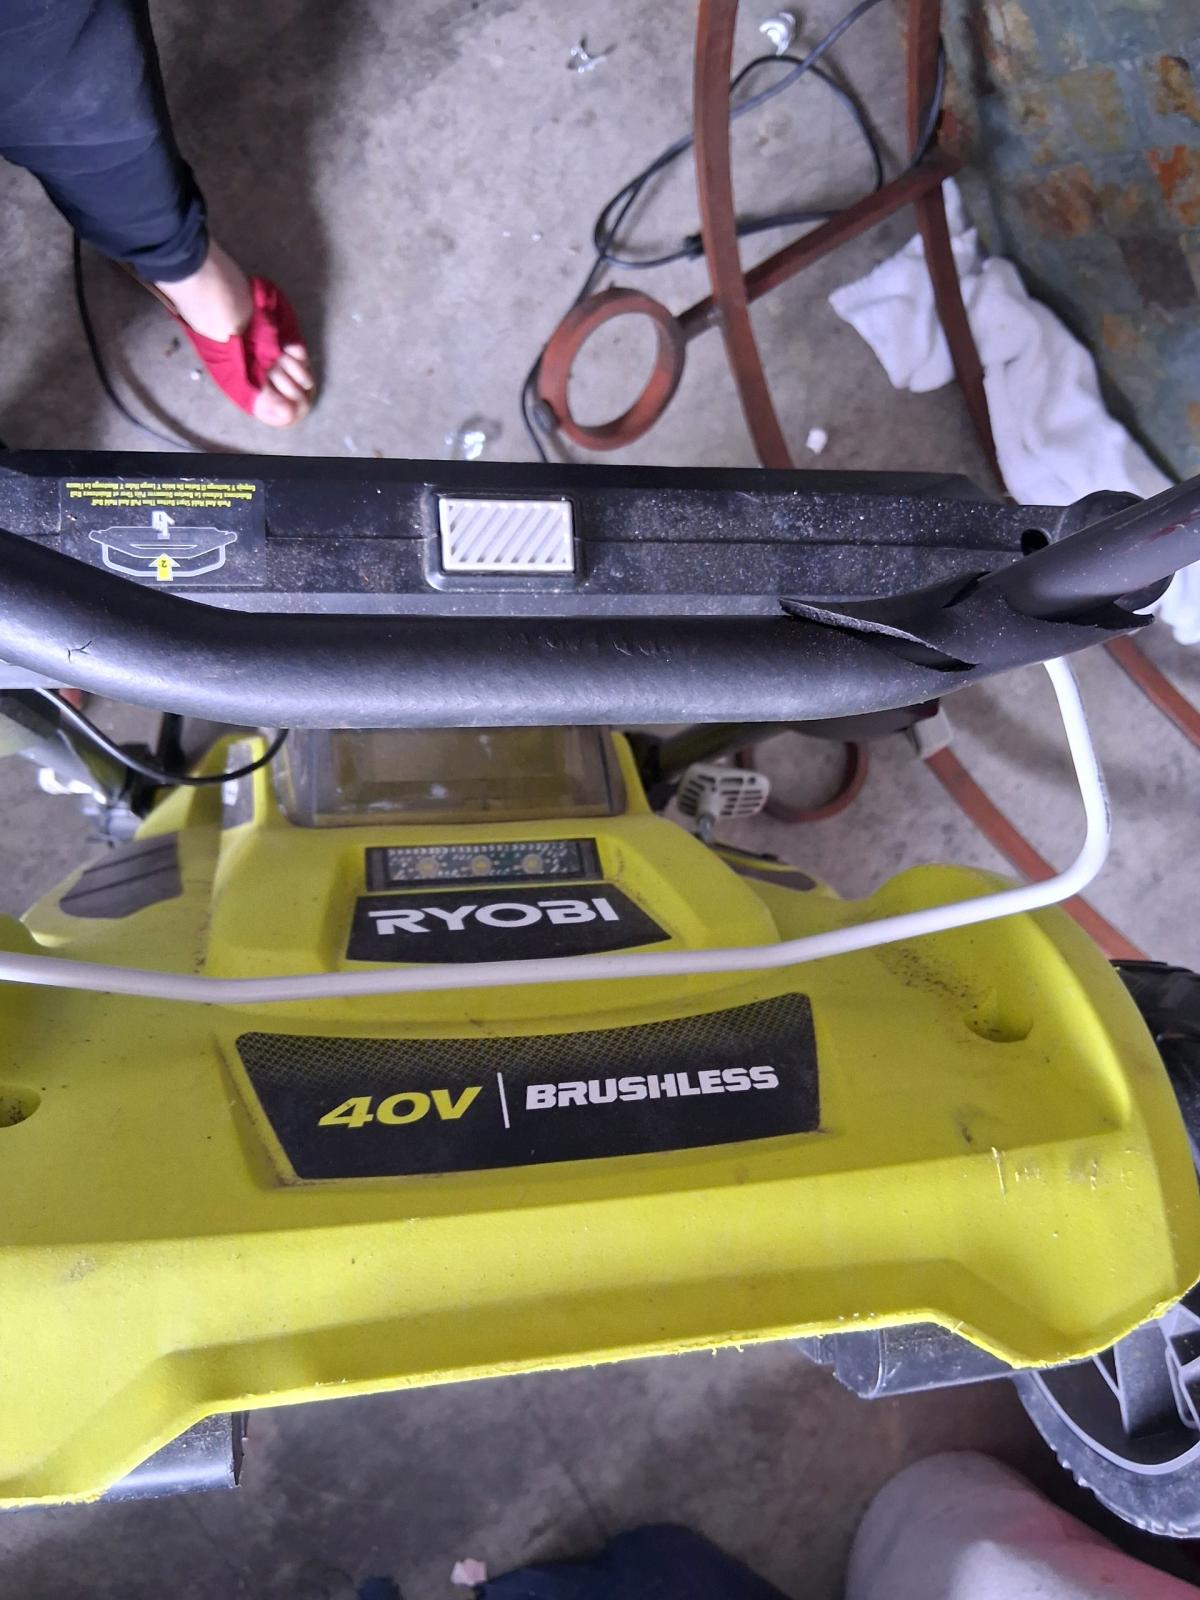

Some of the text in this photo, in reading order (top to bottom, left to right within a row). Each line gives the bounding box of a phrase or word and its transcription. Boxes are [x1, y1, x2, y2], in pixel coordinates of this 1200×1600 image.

[368, 897, 620, 936] RYOBI
[318, 1065, 779, 1129] 40V BRUSHLESS
